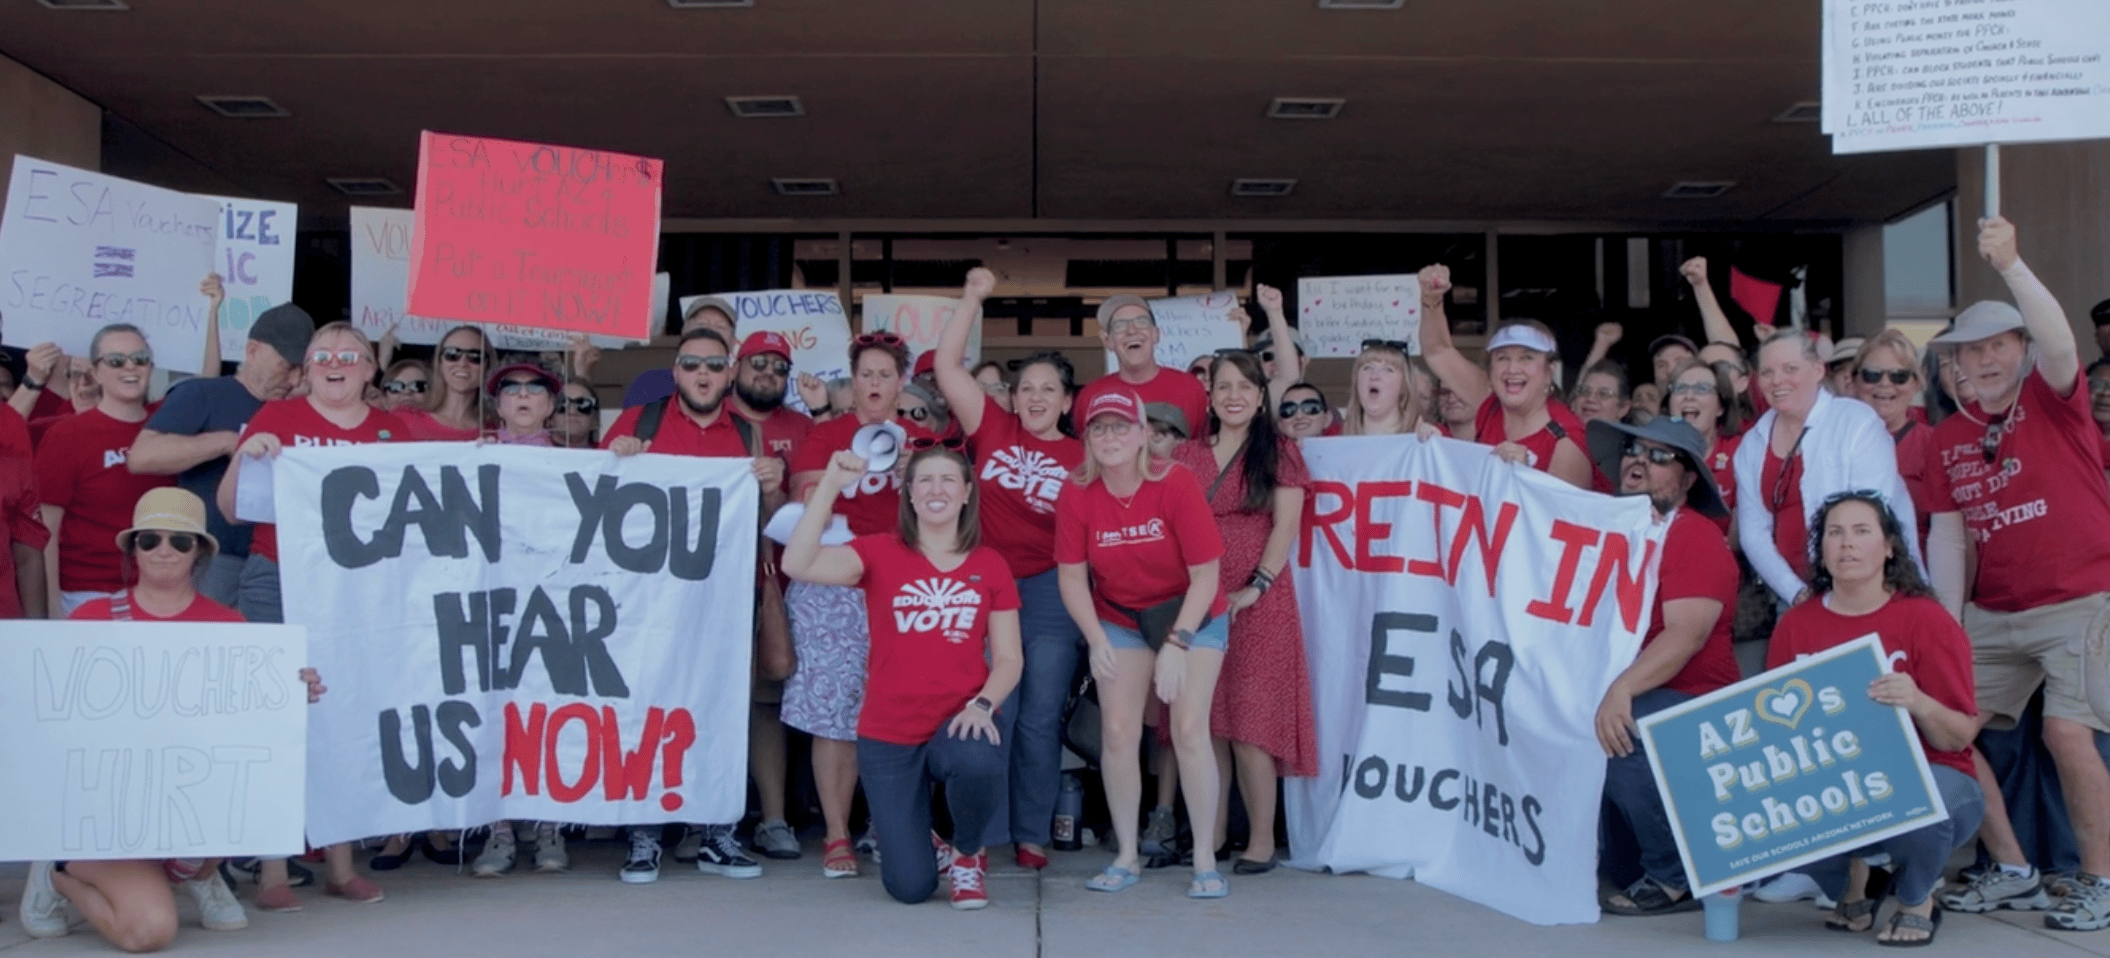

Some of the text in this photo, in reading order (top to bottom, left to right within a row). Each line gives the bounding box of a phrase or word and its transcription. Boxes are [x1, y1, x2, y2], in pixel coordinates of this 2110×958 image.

[1860, 110, 1891, 125] ALL
[1895, 106, 1914, 122] OF
[1917, 104, 1944, 120] THE
[21, 168, 116, 234] ESA
[220, 202, 281, 246] IZE
[8, 268, 203, 333] SEGREGATION
[979, 458, 1064, 502] VOTE
[320, 463, 723, 581] CAN YOU
[1297, 478, 1658, 635] REIN IN
[432, 583, 631, 699] HEAR
[893, 606, 979, 634] VOTE
[32, 645, 290, 722] VOUCHERS
[1365, 610, 1515, 747] ESA
[378, 700, 697, 812] US NOW?
[1706, 726, 1863, 803] Public
[61, 744, 273, 852] HURT
[1710, 769, 1894, 850] Schools
[1729, 856, 1751, 870] SAVE
[1750, 851, 1770, 863] OUR
[1770, 837, 1810, 857] SCHOOLS
[1810, 825, 1850, 844] ARIZONA
[1849, 811, 1896, 832] NETWORK
